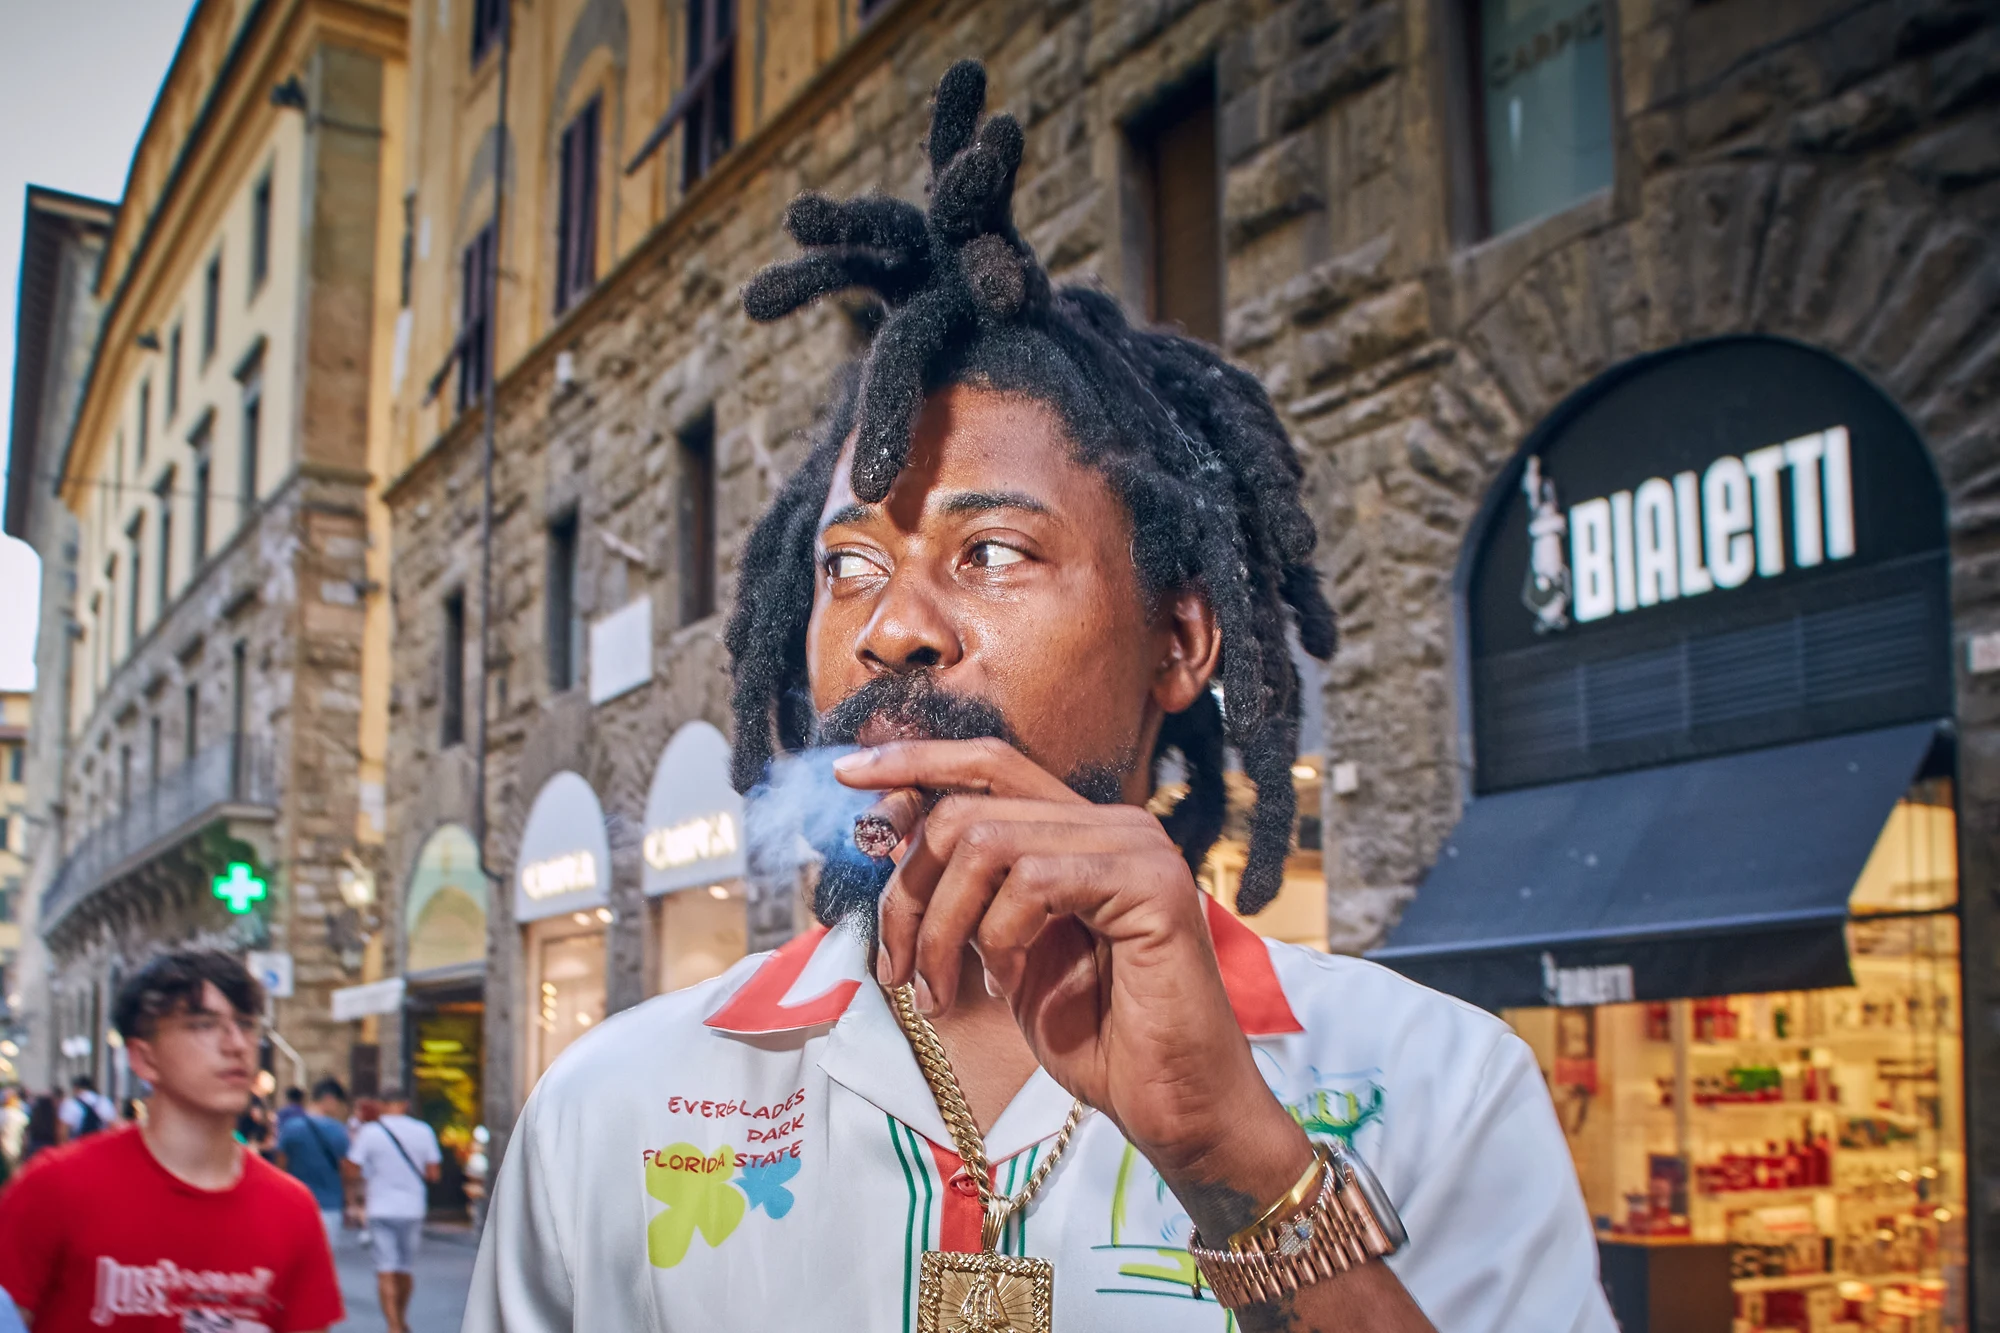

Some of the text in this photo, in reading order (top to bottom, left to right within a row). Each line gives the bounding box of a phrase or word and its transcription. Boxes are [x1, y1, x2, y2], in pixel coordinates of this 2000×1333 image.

[667, 1087, 806, 1120] EVERGLADES
[746, 1112, 805, 1144] PARK
[642, 1139, 804, 1174] FLORIDA STATE
